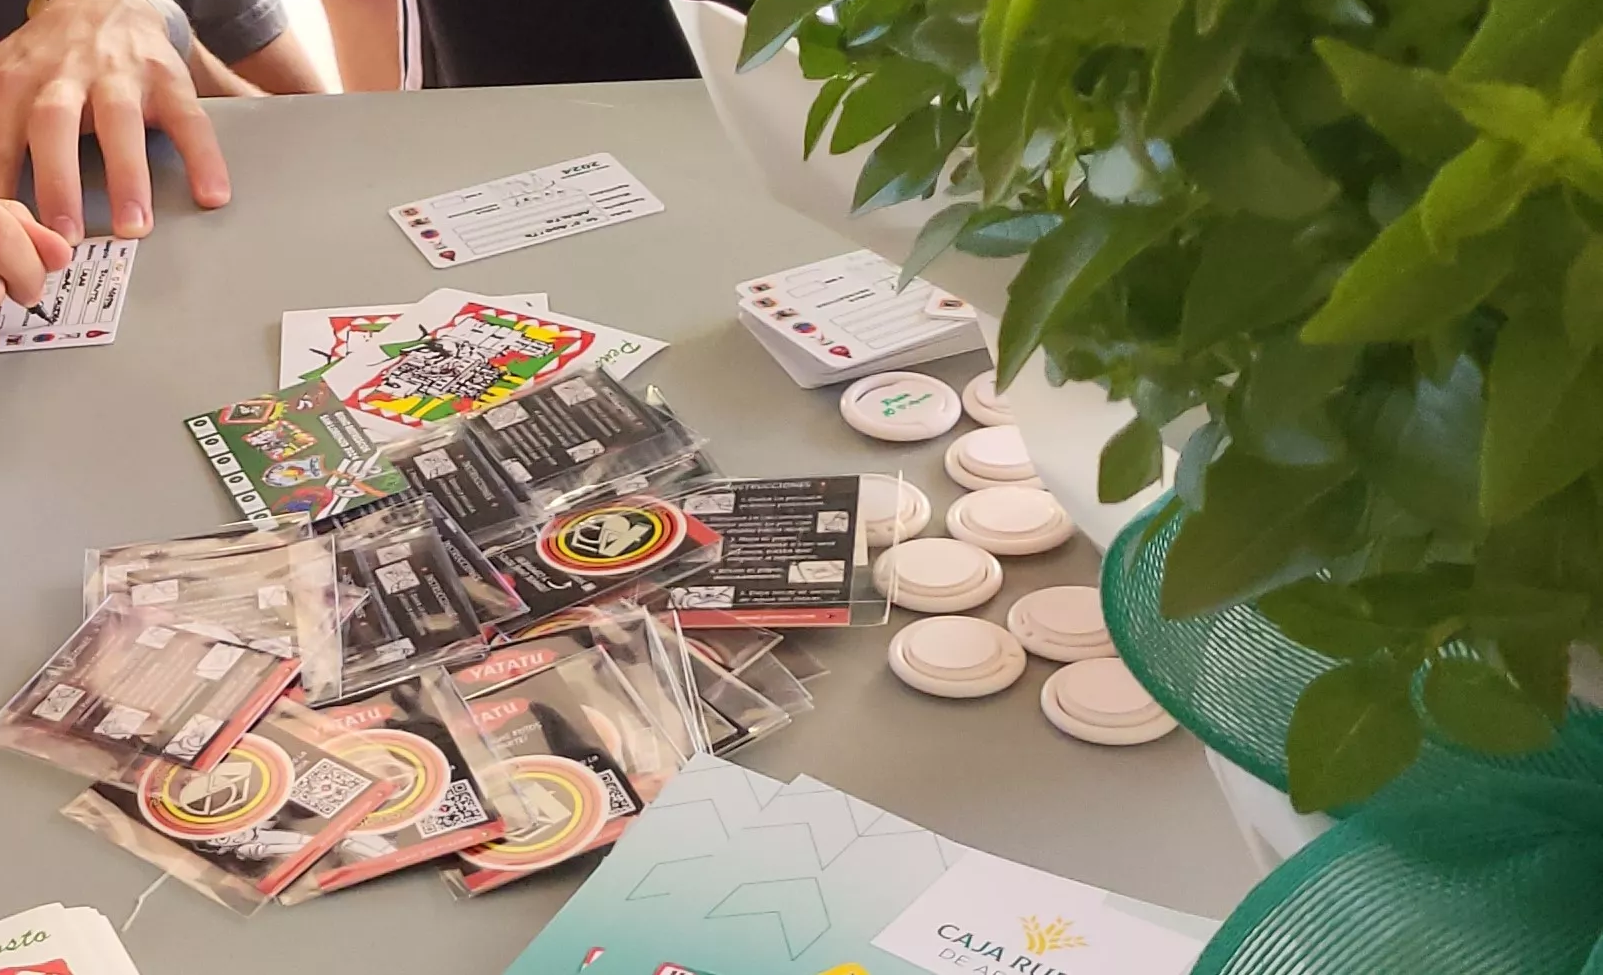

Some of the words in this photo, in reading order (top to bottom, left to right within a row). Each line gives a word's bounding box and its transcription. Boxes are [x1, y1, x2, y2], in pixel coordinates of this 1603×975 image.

[560, 160, 601, 175] 2024
[469, 650, 545, 679] YATATU
[937, 924, 1004, 962] CAJA
[1009, 955, 1068, 975] RU
[938, 947, 972, 966] DE
